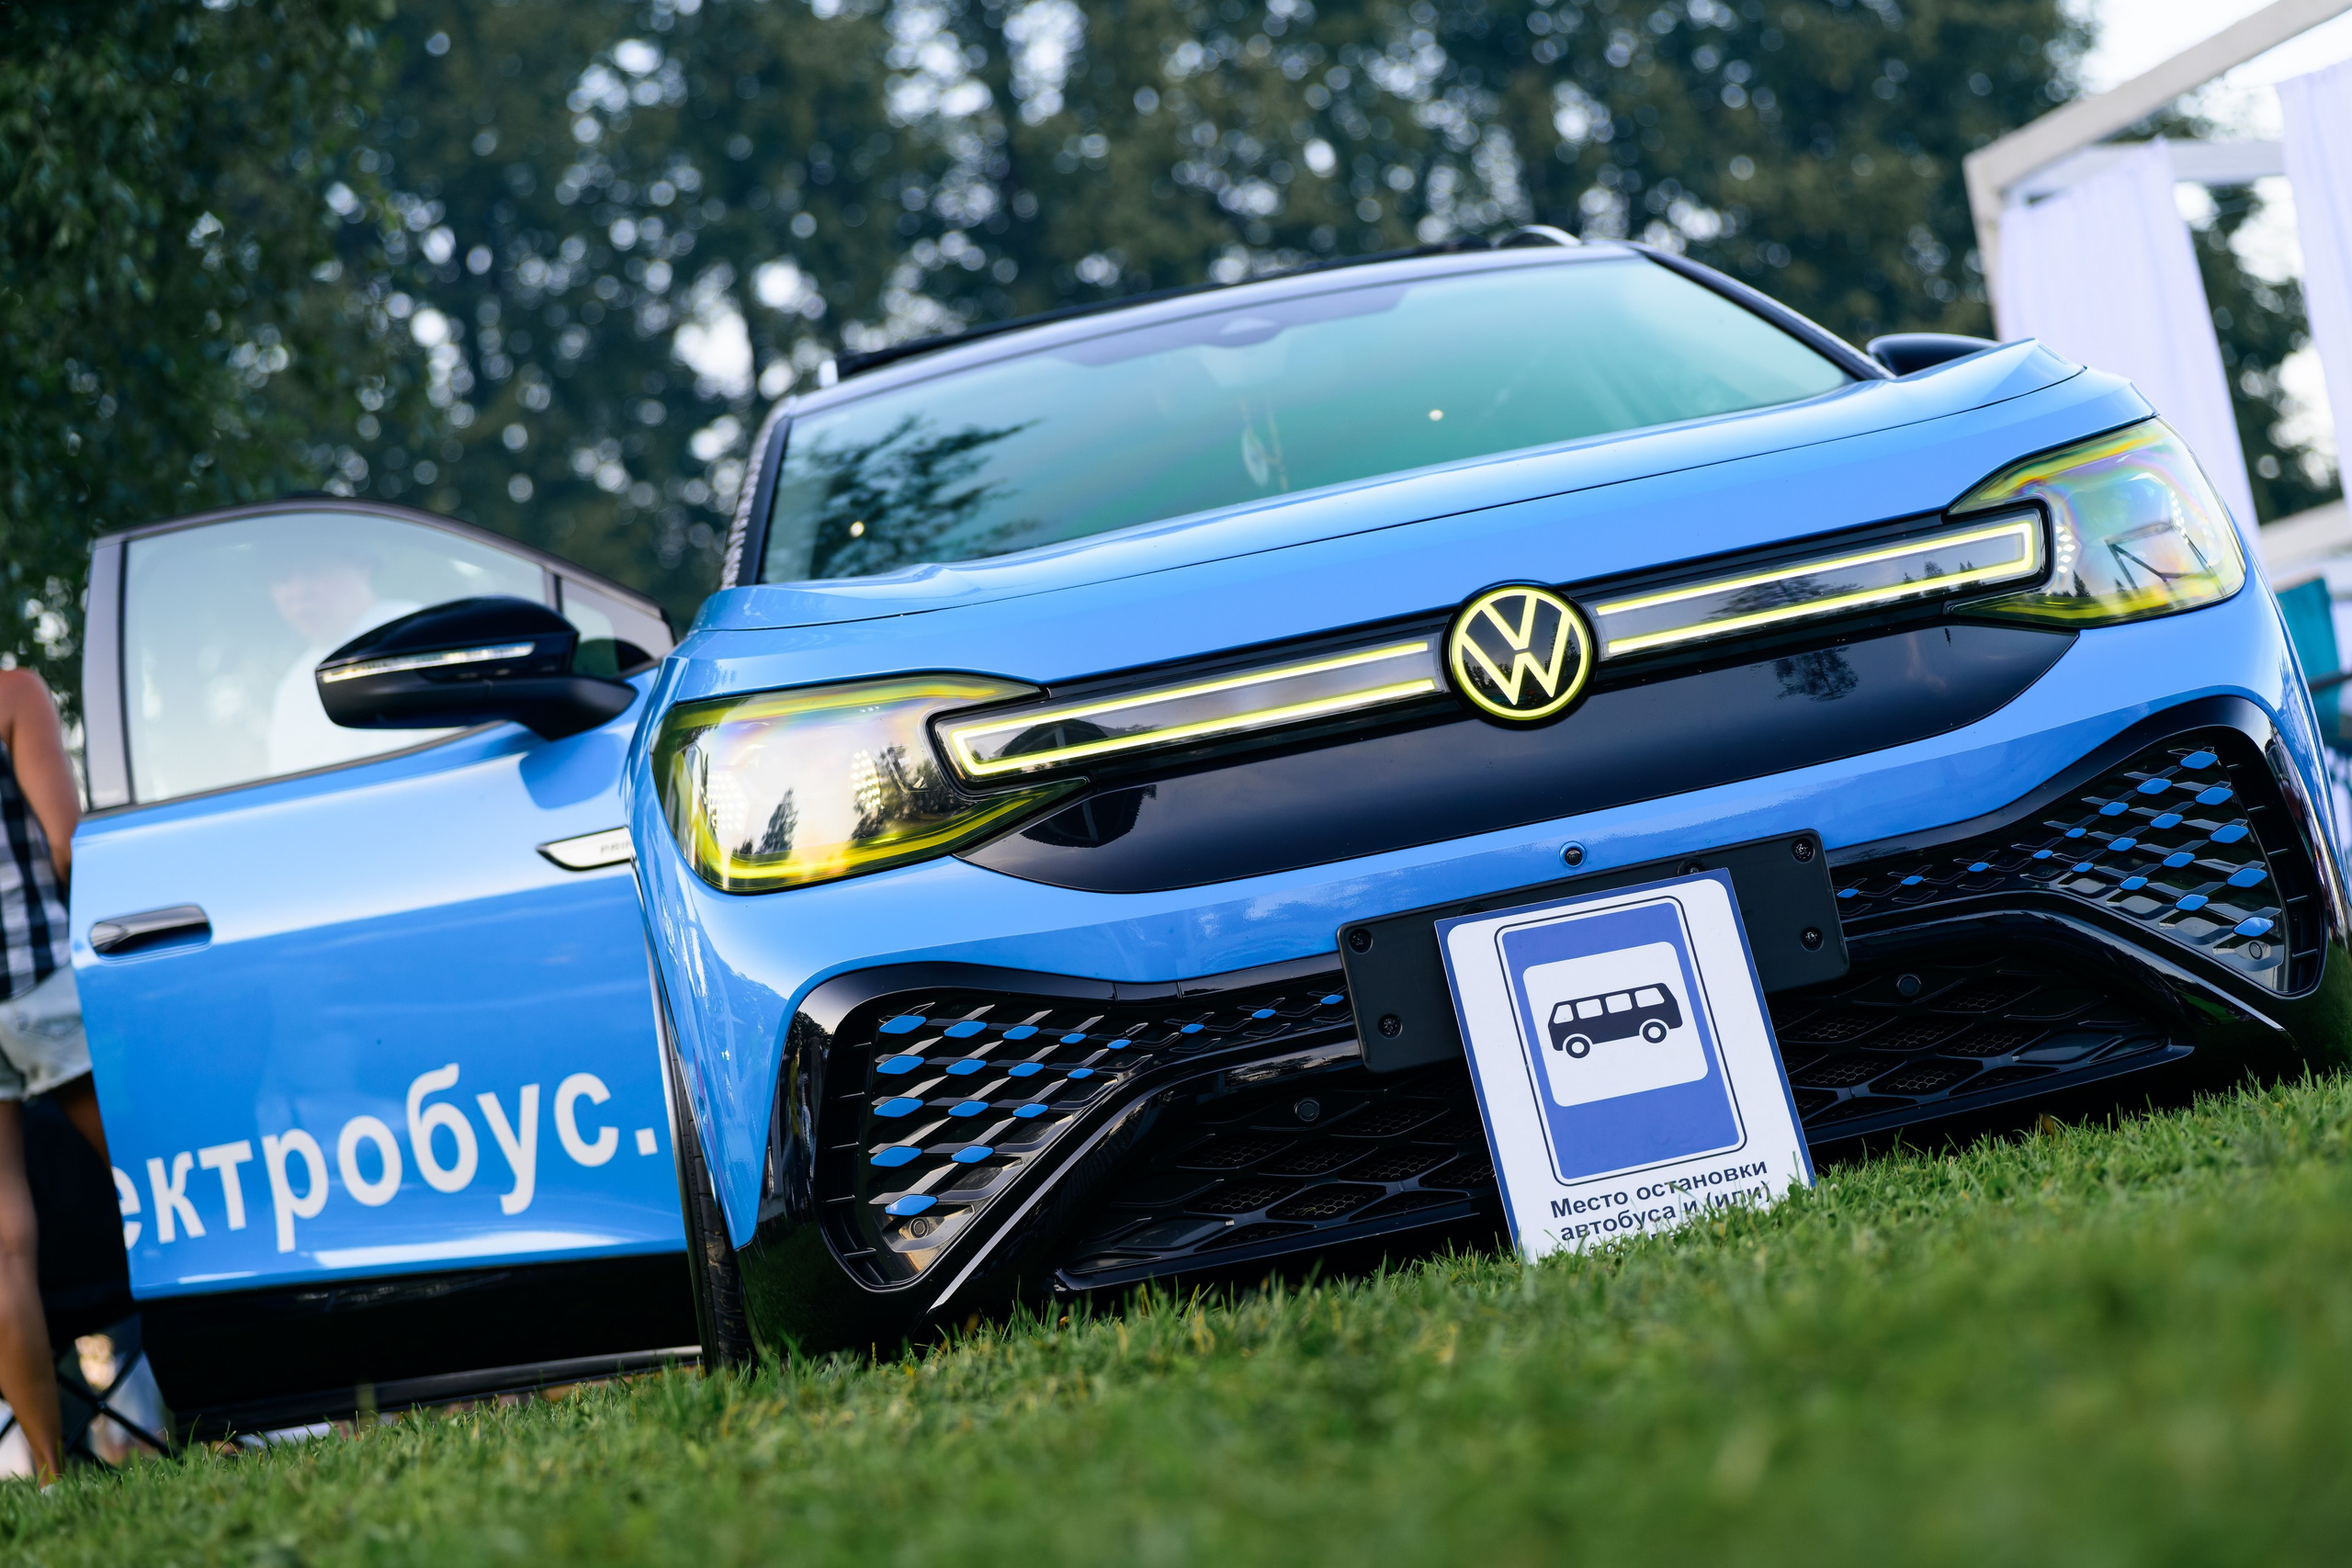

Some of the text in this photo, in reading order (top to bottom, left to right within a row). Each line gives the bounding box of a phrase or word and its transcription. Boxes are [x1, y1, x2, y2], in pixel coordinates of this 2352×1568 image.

[1456, 591, 1580, 710] VW
[1550, 1160, 1768, 1219] Место остановки
[1560, 1180, 1770, 1242] автобуса и (или)
